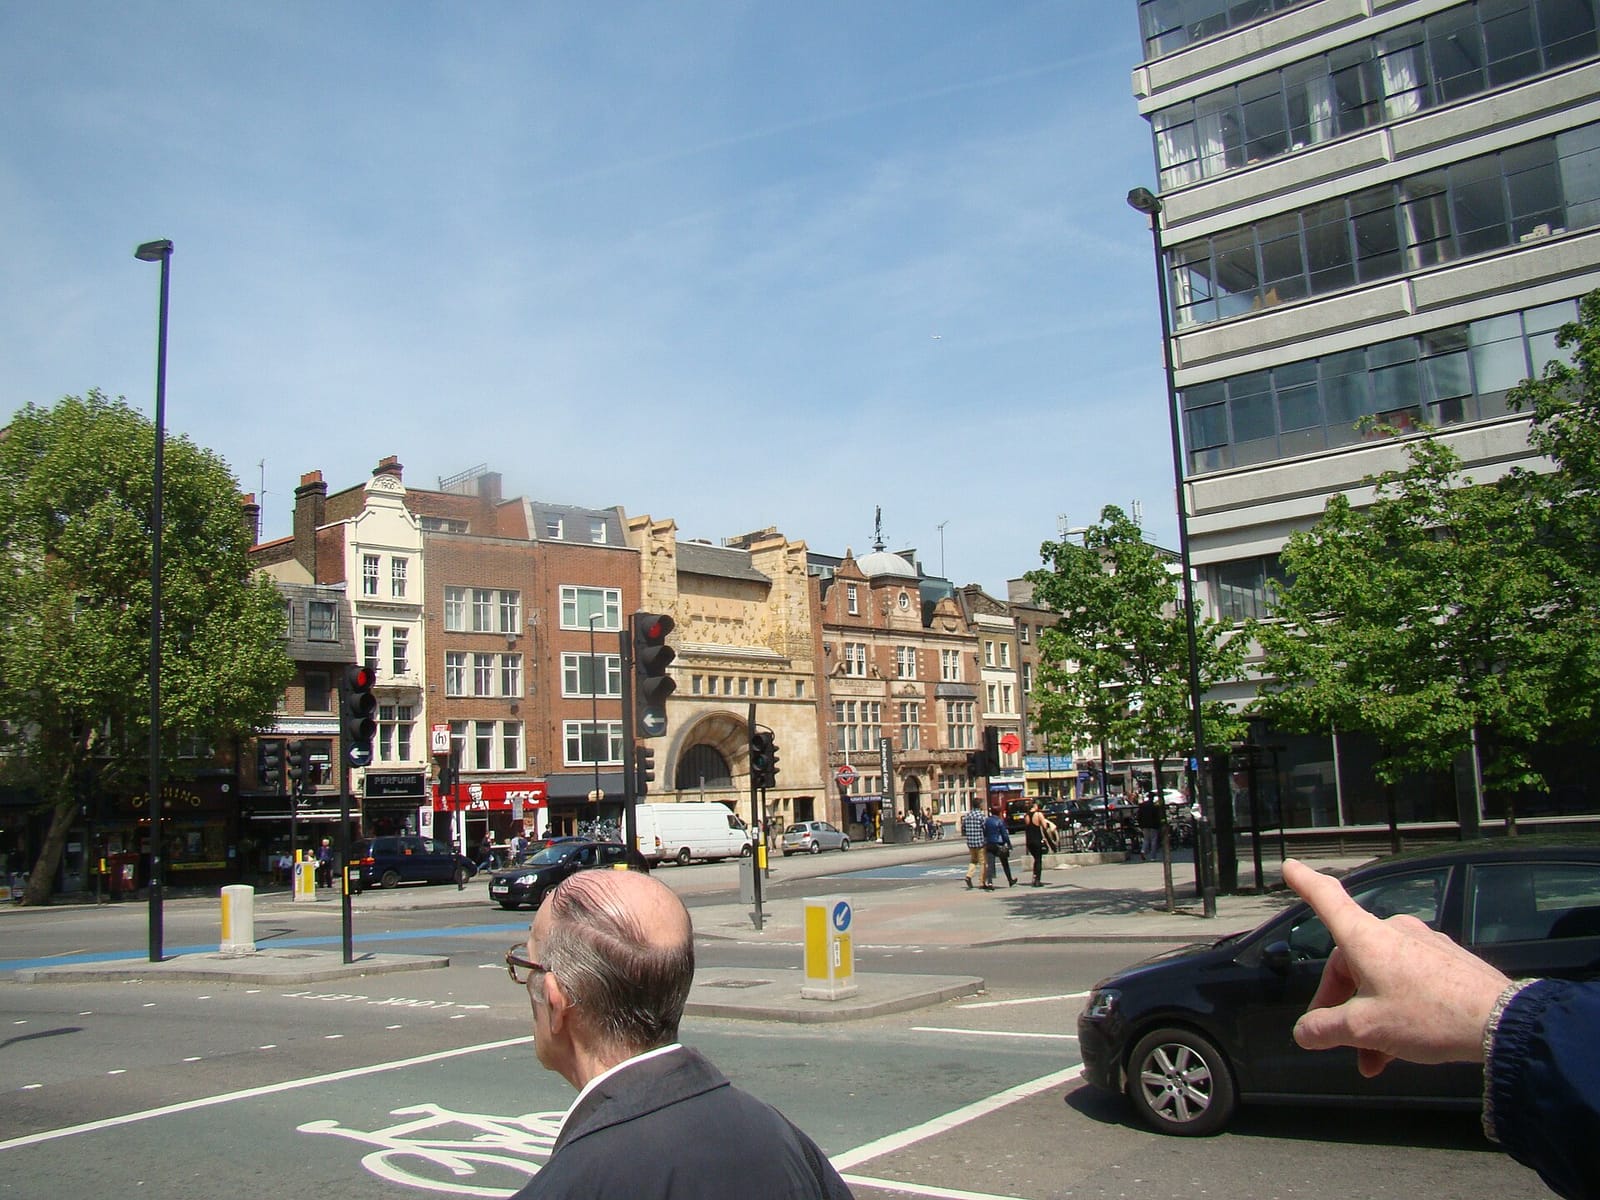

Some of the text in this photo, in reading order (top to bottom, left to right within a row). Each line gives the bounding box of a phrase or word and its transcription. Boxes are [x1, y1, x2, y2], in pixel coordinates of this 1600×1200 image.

[374, 776, 417, 785] PERFUME
[132, 788, 201, 808] CAHINO
[281, 991, 454, 1008] LOOK LEFT
